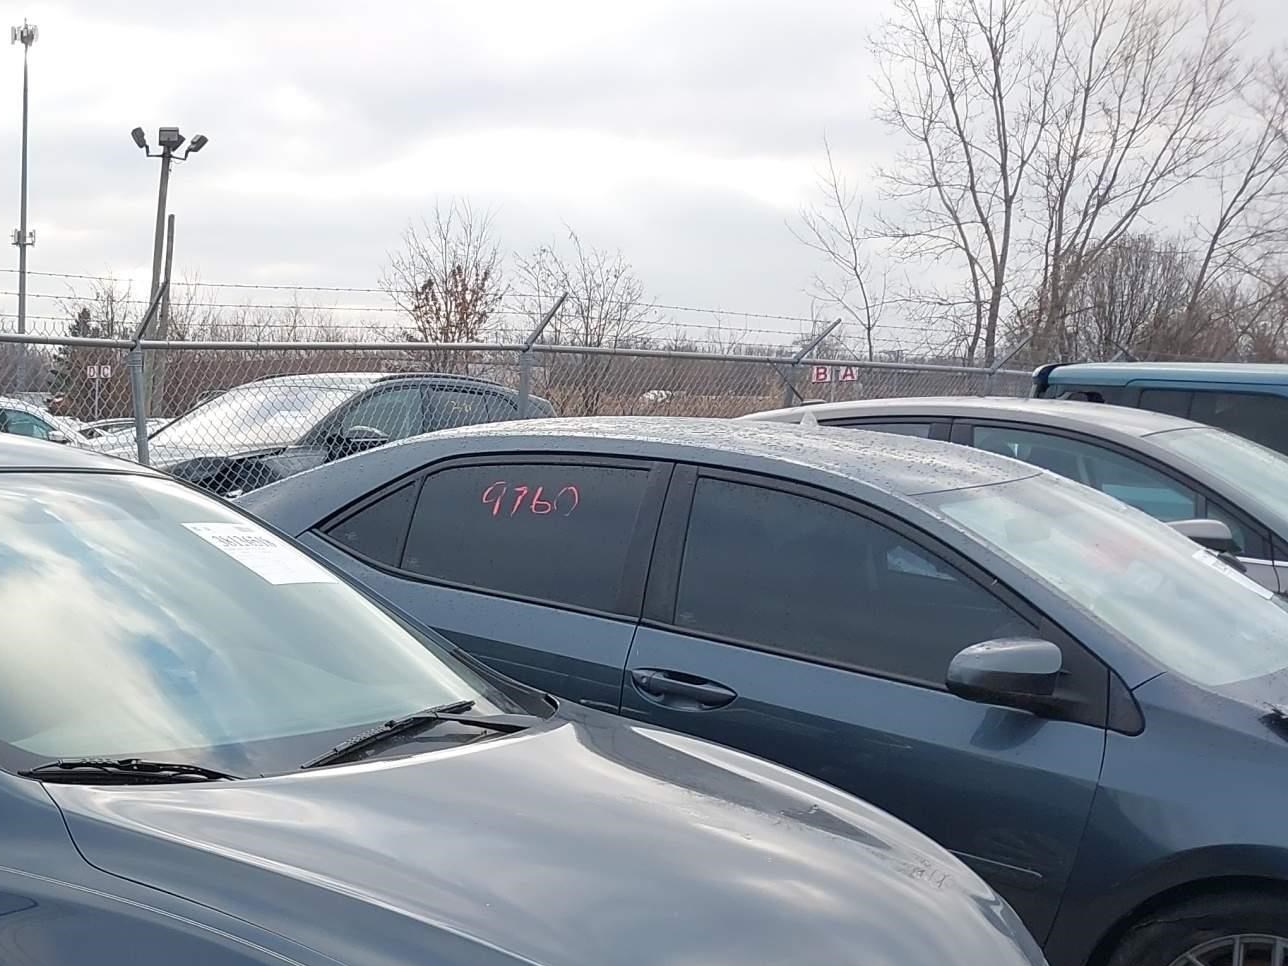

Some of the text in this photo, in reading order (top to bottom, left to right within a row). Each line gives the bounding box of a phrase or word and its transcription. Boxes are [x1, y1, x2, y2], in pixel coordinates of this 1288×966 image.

[815, 366, 828, 382] B
[842, 366, 855, 380] A
[481, 480, 580, 517] 9760
